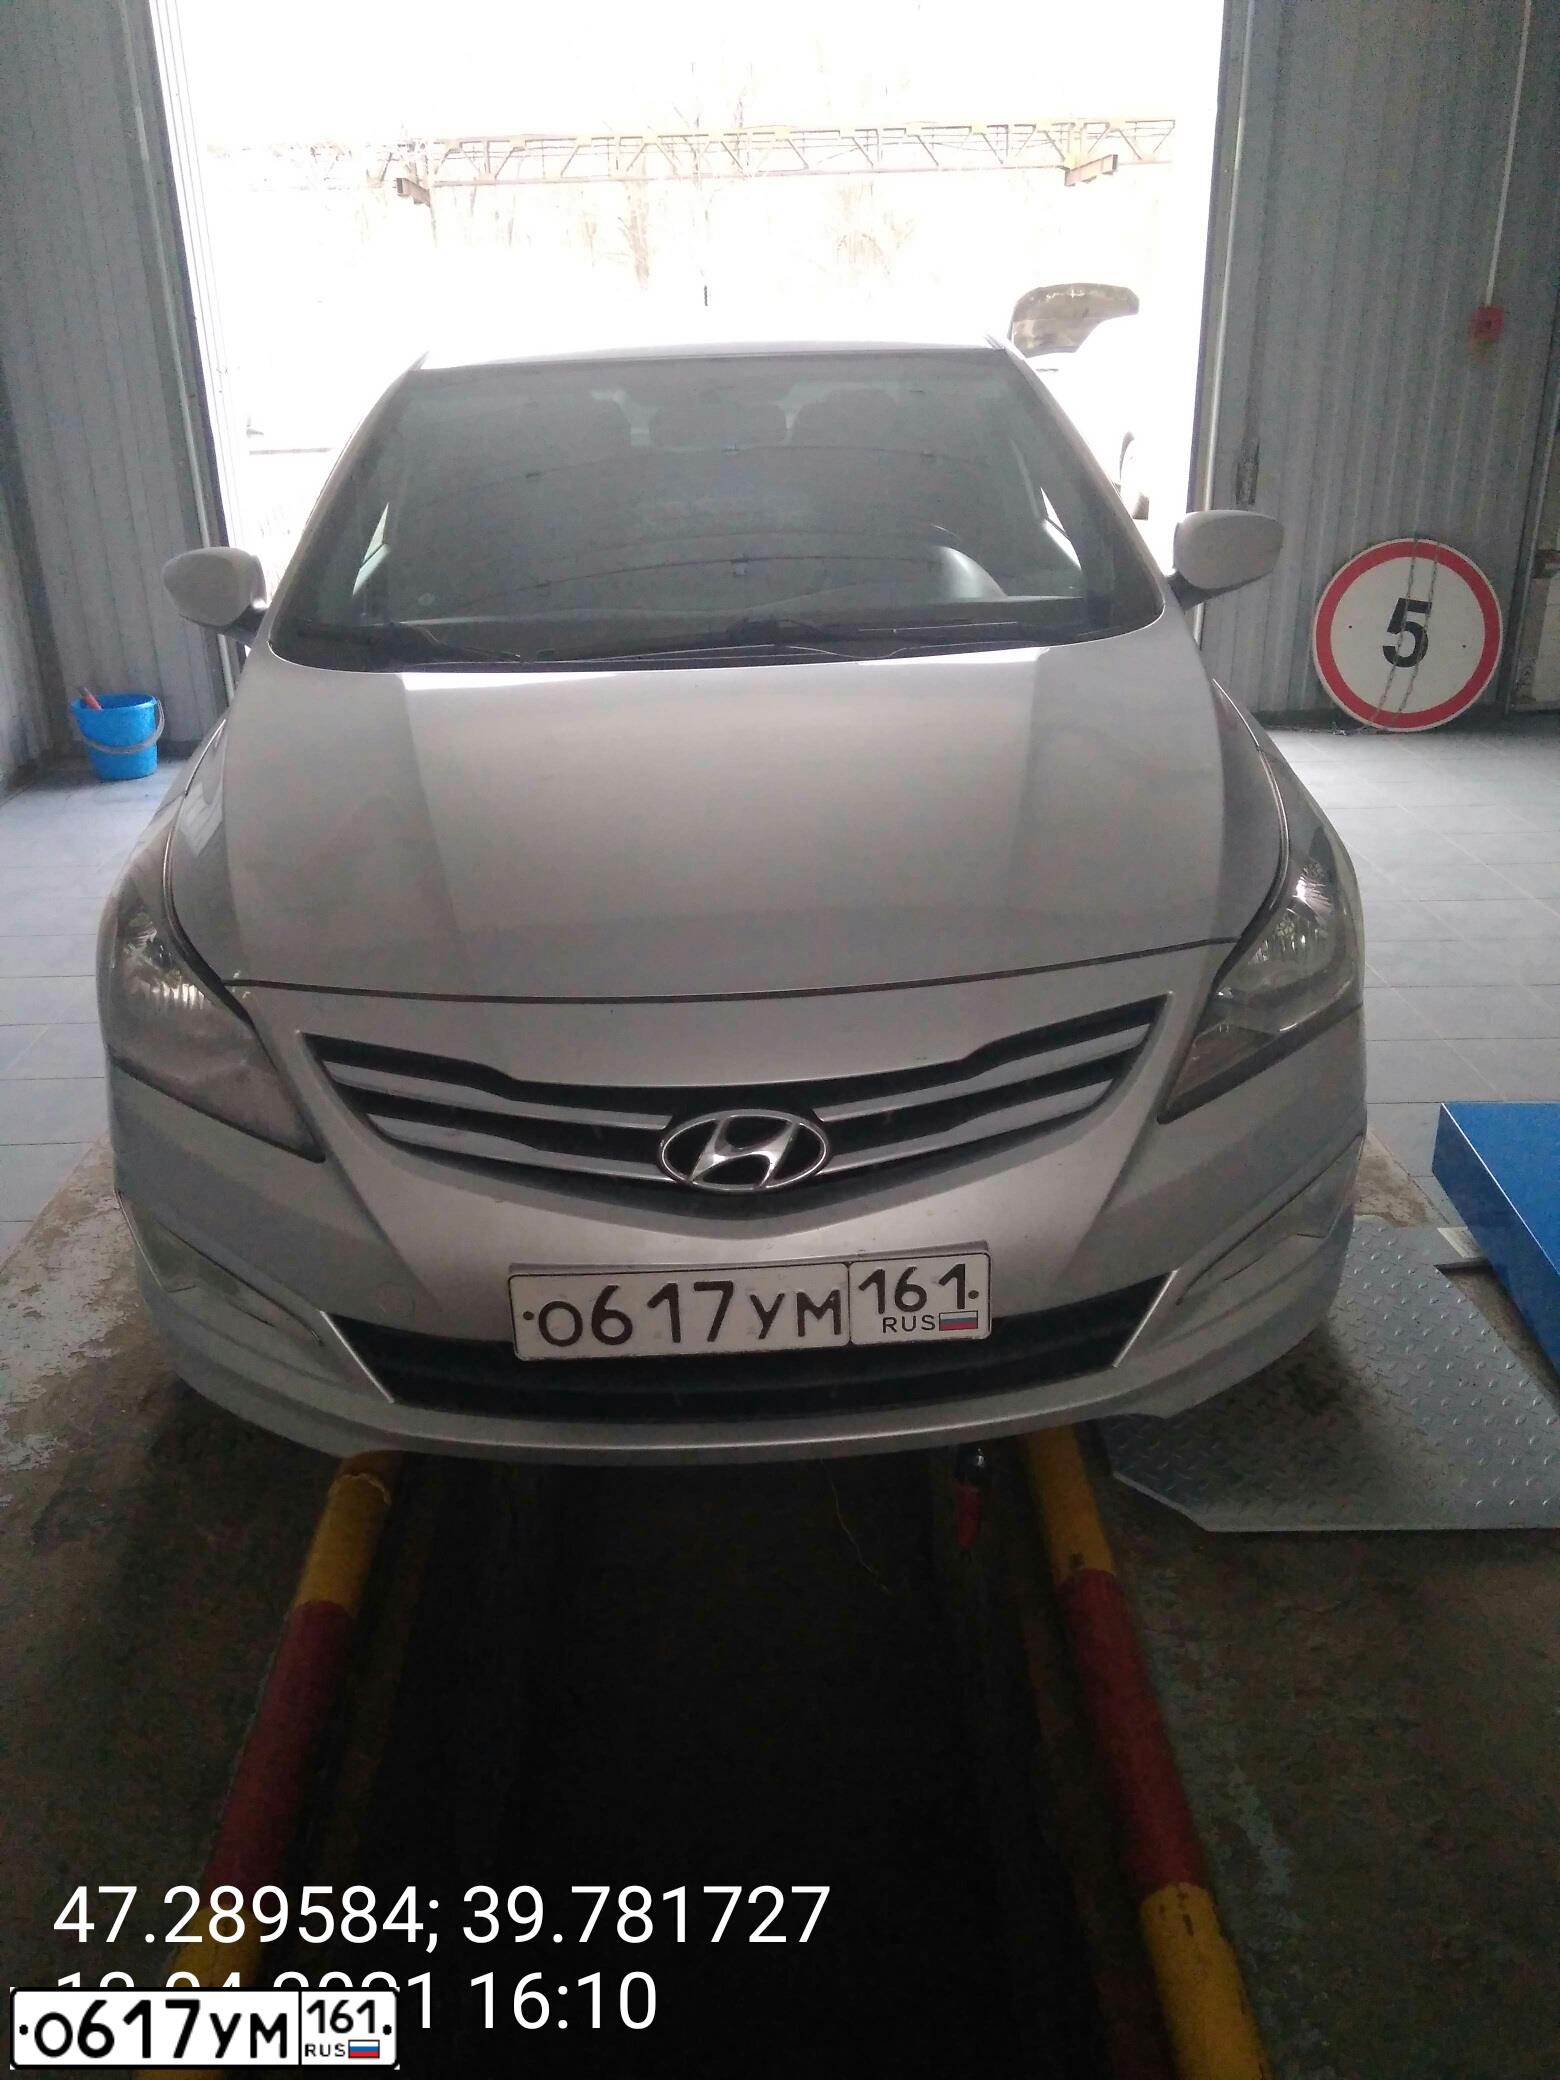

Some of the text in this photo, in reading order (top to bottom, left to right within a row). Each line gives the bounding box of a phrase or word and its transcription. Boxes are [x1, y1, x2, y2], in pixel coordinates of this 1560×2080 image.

[1382, 597, 1432, 668] 5
[857, 1263, 967, 1315] 161
[882, 1314, 936, 1334] RUS
